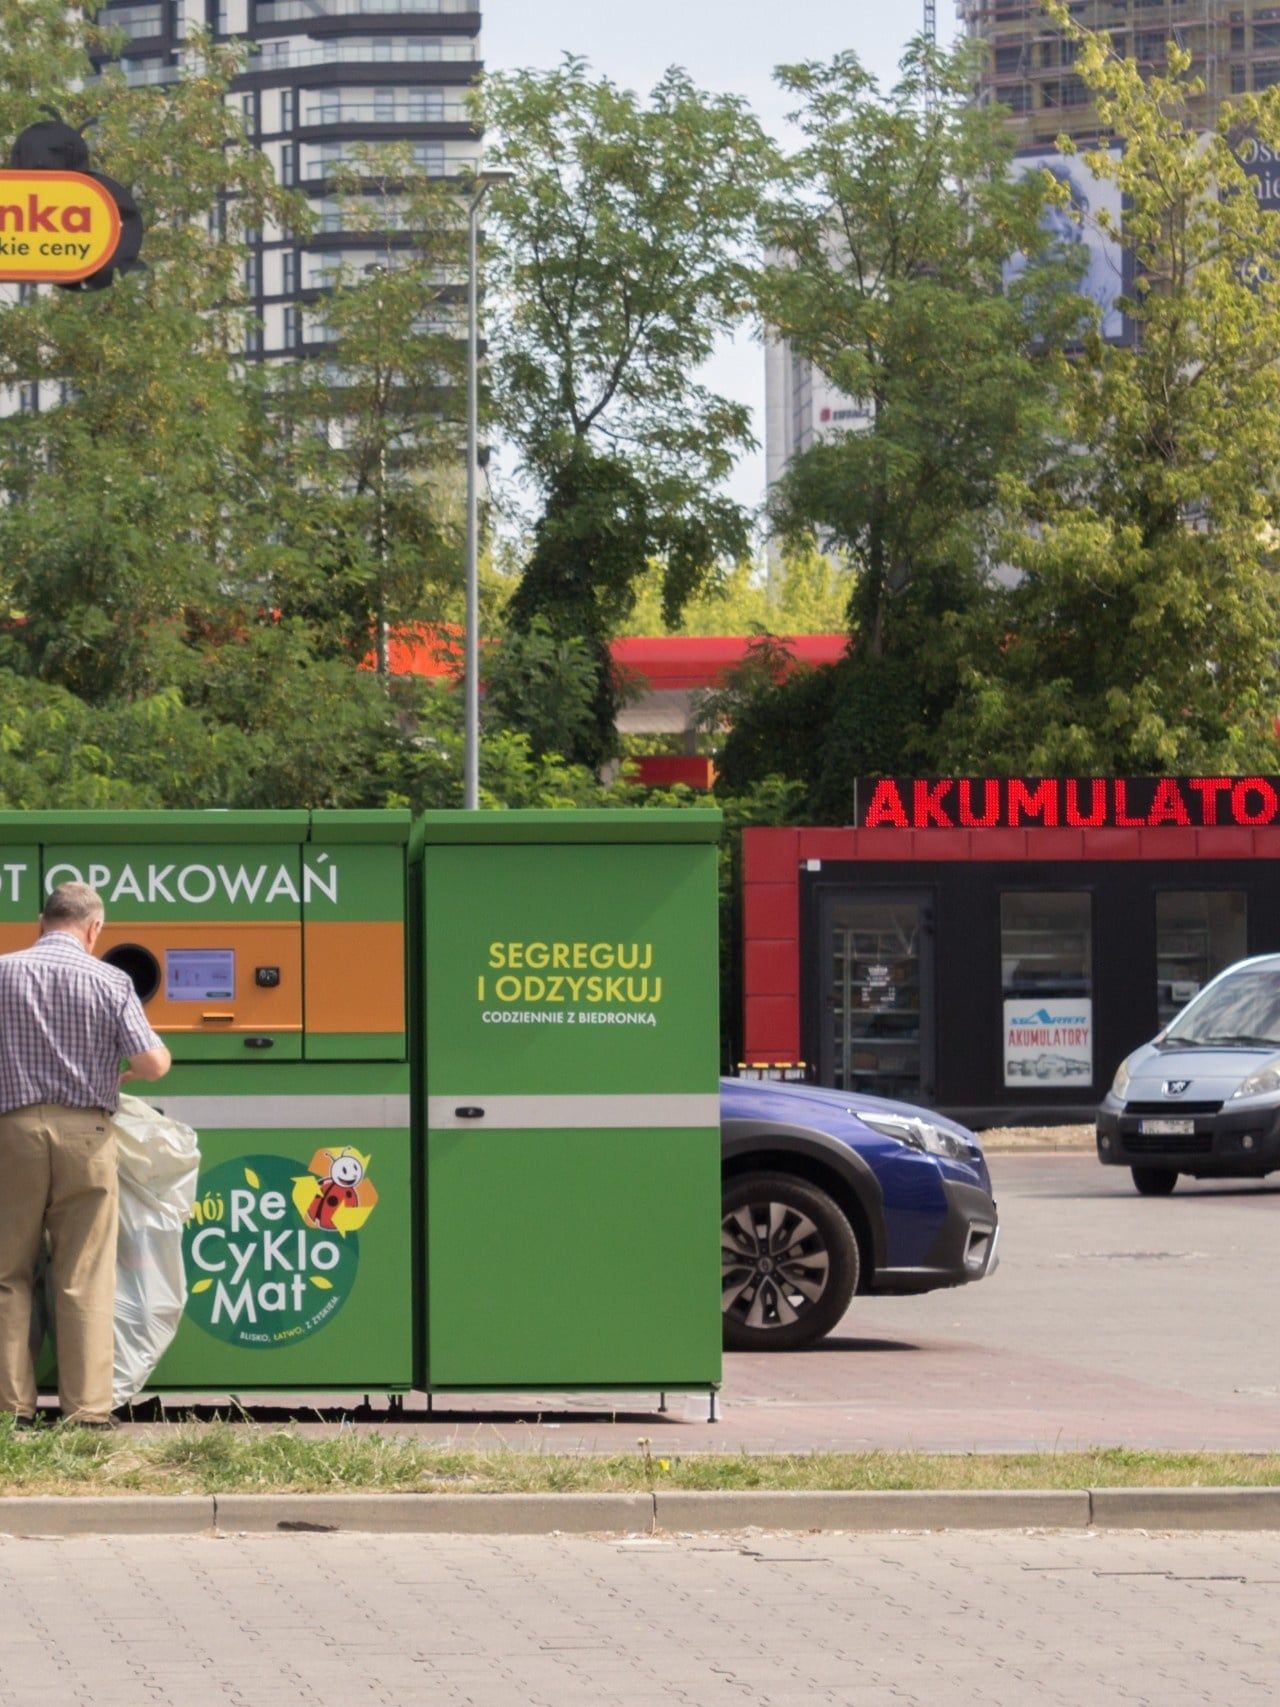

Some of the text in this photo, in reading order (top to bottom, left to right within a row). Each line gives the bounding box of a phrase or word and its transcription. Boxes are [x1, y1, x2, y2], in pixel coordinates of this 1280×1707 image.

[39, 242, 91, 260] ceny
[865, 778, 1278, 827] AKUMULATO
[45, 852, 338, 904] OPAKOWAŃ
[489, 942, 653, 969] SEGREGUJ
[478, 976, 662, 1002] I ODZYSKUJ
[482, 1011, 657, 1026] CODZIENNIE Z BIEDRONKĄ
[1008, 1028, 1089, 1047] AKUMULATORY
[230, 1189, 287, 1232] Re
[191, 1227, 340, 1285] CyKlo
[210, 1274, 306, 1325] Mat
